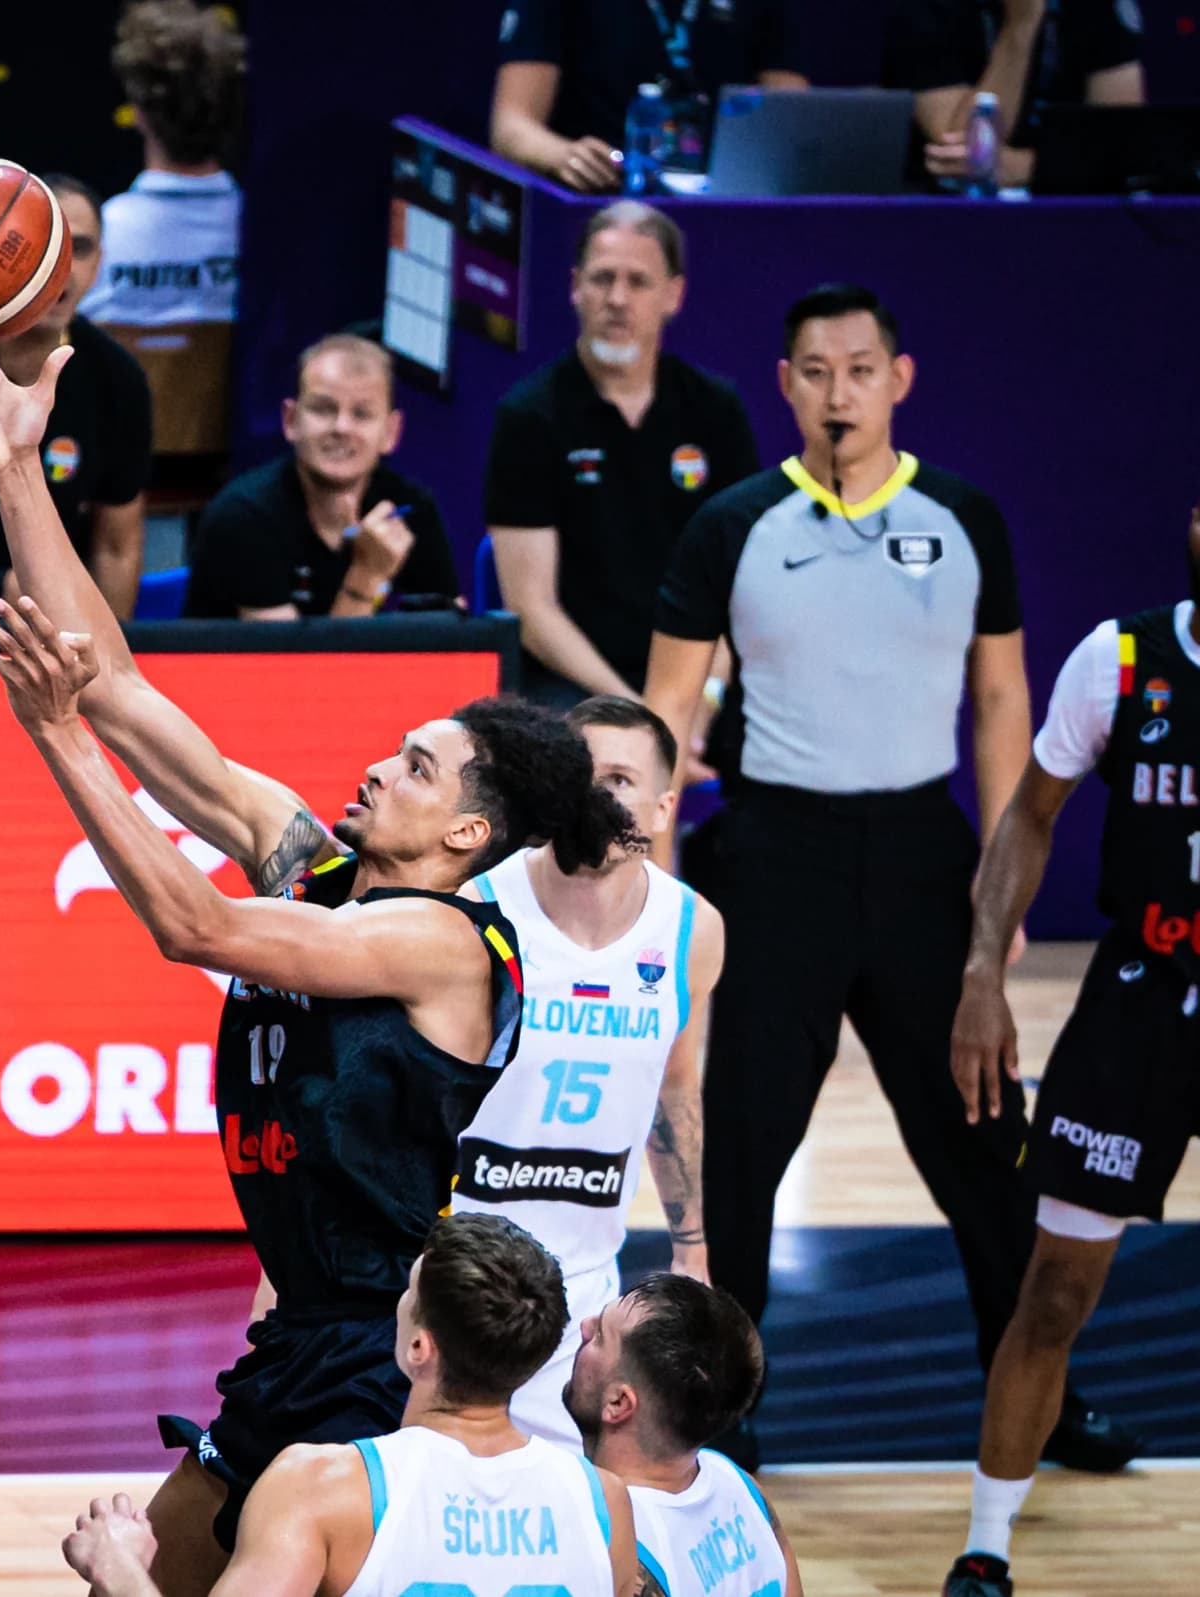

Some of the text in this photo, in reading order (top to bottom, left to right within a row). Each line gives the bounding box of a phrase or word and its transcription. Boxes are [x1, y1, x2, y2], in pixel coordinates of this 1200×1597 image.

[248, 1023, 286, 1085] 19
[540, 1058, 611, 1125] 15
[1050, 1115, 1142, 1161] POWER
[474, 1154, 622, 1193] telemach
[443, 1492, 558, 1556] ŠČUKA
